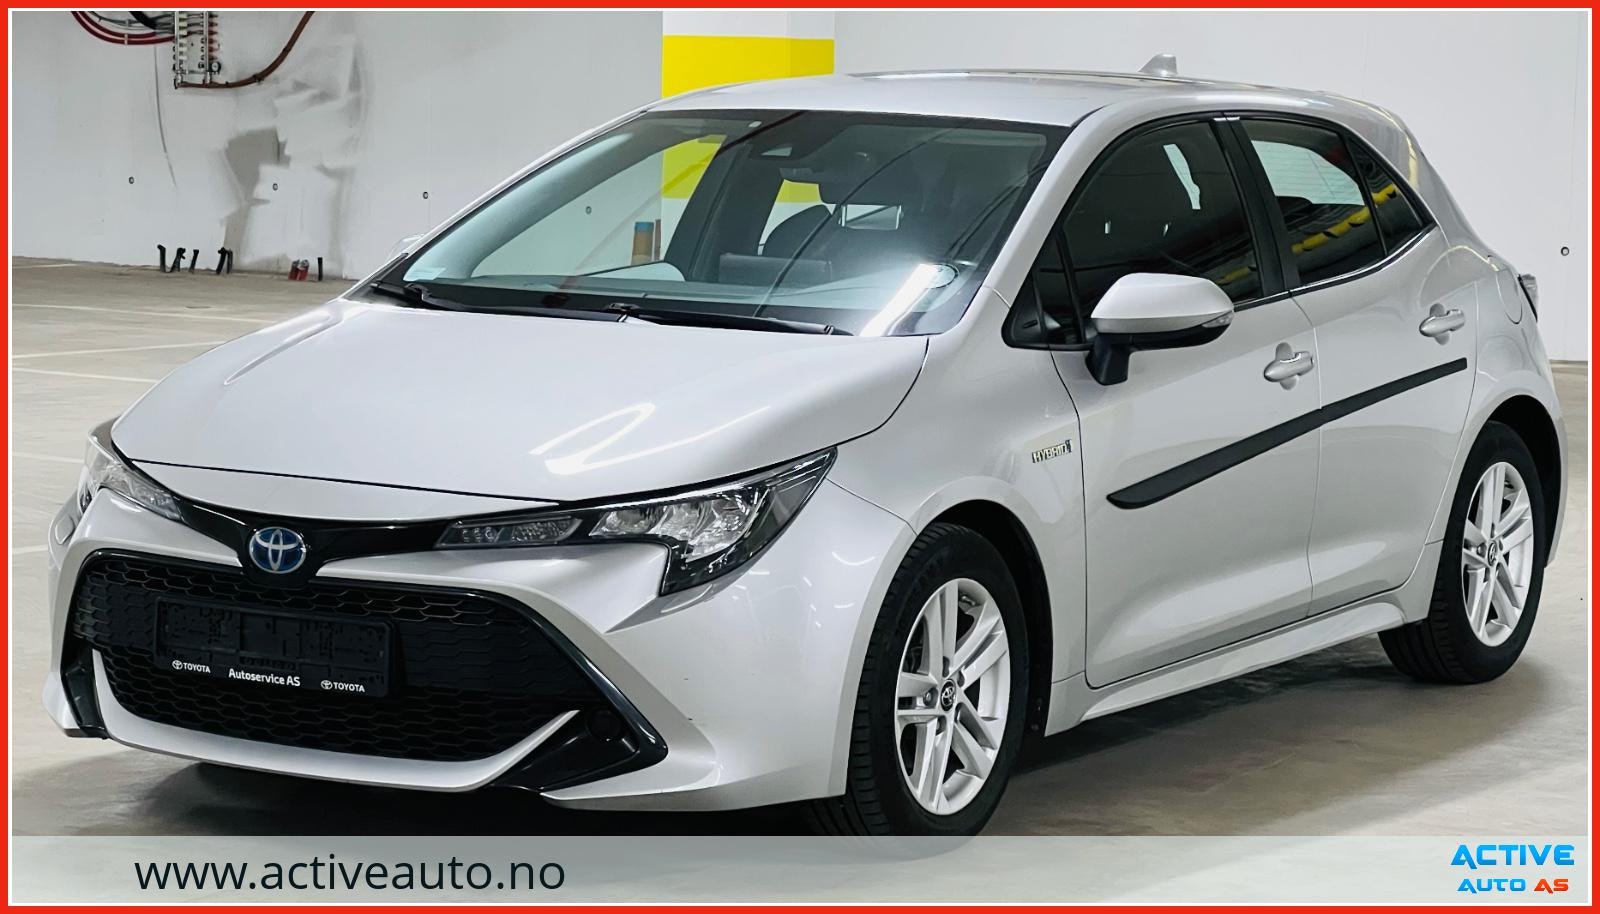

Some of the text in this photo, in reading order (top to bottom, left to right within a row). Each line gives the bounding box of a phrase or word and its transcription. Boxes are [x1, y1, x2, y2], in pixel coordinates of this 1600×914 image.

[1032, 442, 1068, 463] HYBRID
[183, 662, 211, 674] TOYOTA
[229, 668, 301, 687] Autoservice AS
[333, 681, 366, 693] TOYOTA
